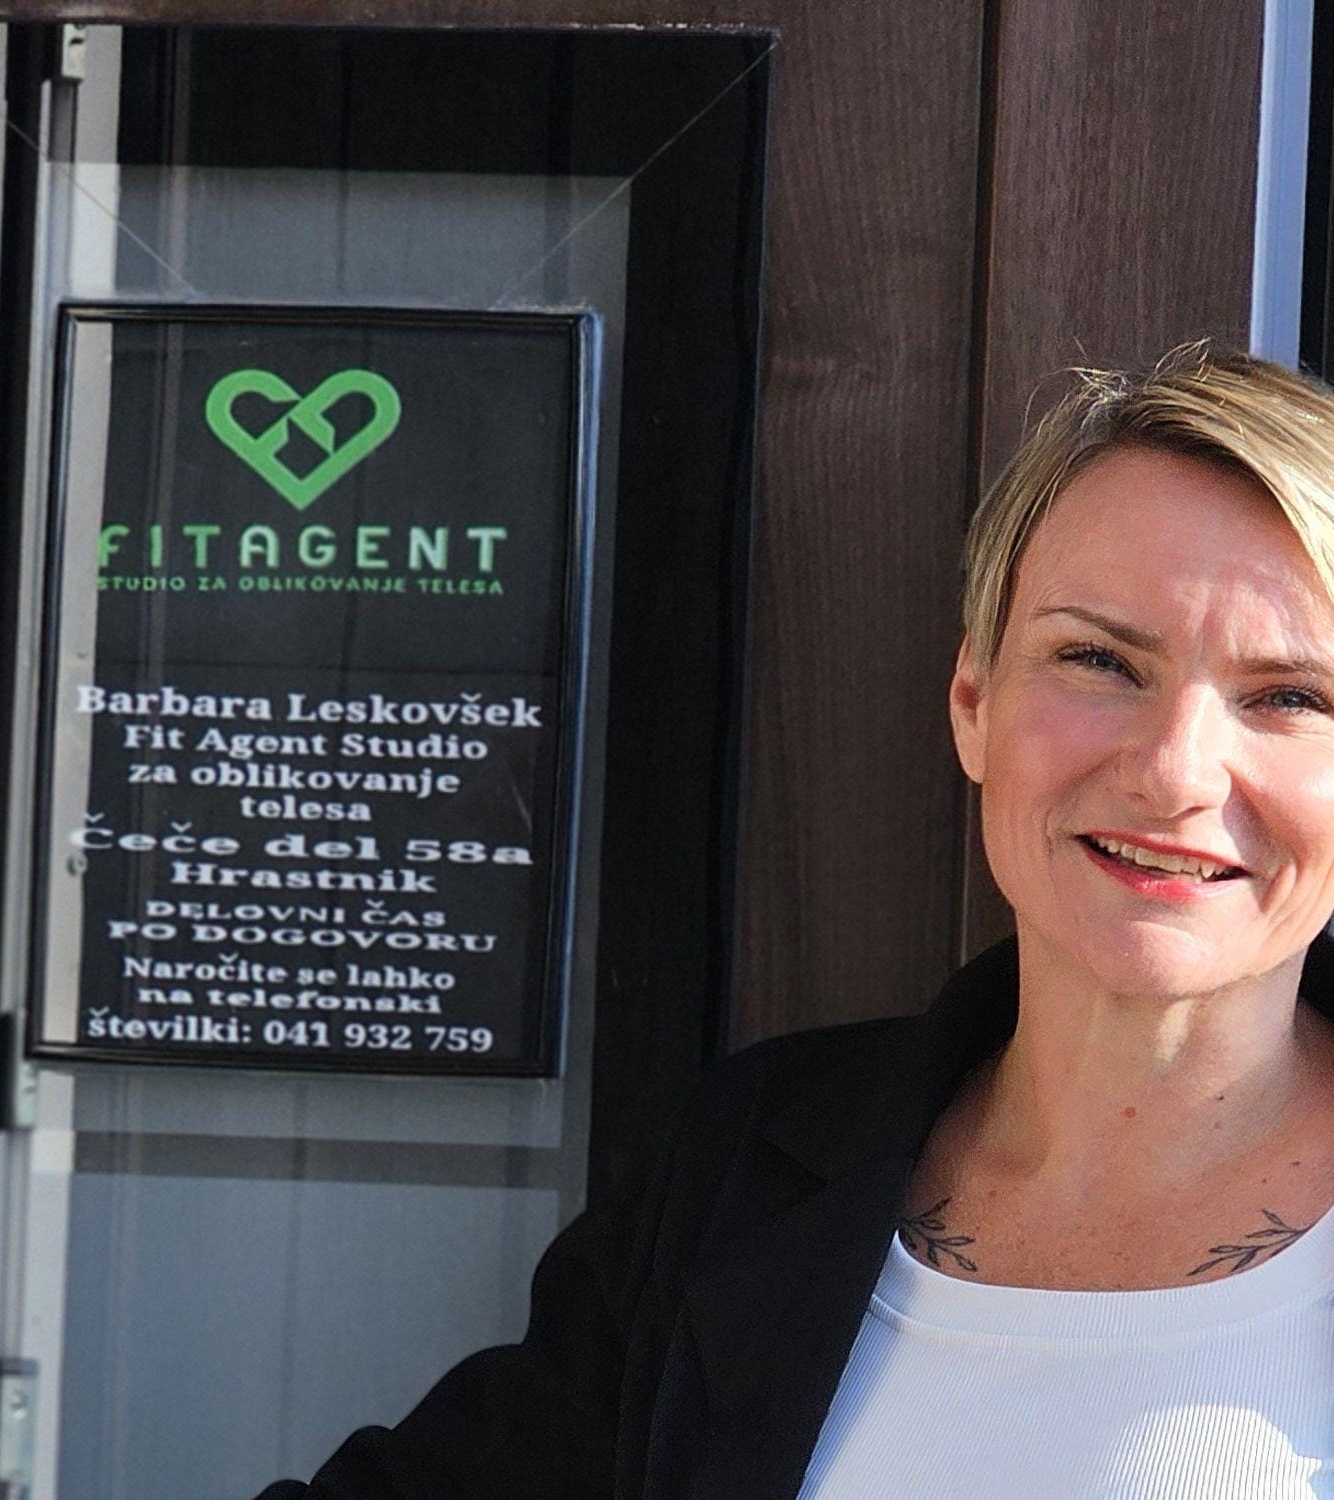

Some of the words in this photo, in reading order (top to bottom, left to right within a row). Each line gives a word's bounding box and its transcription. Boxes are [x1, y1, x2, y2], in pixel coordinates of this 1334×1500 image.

[96, 575, 187, 592] STUDIO
[198, 576, 227, 592] ZA
[240, 577, 407, 594] OBLIKOVANJE
[419, 578, 503, 595] TELESA
[76, 685, 272, 718] Barbara
[287, 693, 542, 728] Leskovšek
[124, 725, 184, 749] Fit
[196, 727, 327, 759] Agent
[340, 732, 488, 761] Studio
[128, 765, 177, 785] za
[191, 762, 461, 799] oblikovanje
[240, 796, 371, 821] telesa
[69, 812, 240, 854] Čeče
[264, 834, 380, 860] del
[405, 839, 534, 866] 58a
[171, 862, 436, 893] Hrastnik
[146, 901, 345, 924] DELOVNI
[361, 900, 447, 927] ČAS
[107, 921, 177, 941] PO
[192, 924, 497, 952] DOGOVORU
[123, 953, 289, 984] Naročite
[297, 966, 337, 986] se
[346, 964, 455, 991] lahko
[138, 986, 193, 1005] na
[208, 986, 442, 1014] telefonski
[88, 1006, 251, 1044] številki:
[263, 1019, 330, 1048] 041
[344, 1024, 412, 1051] 932
[425, 1026, 494, 1053] 759
